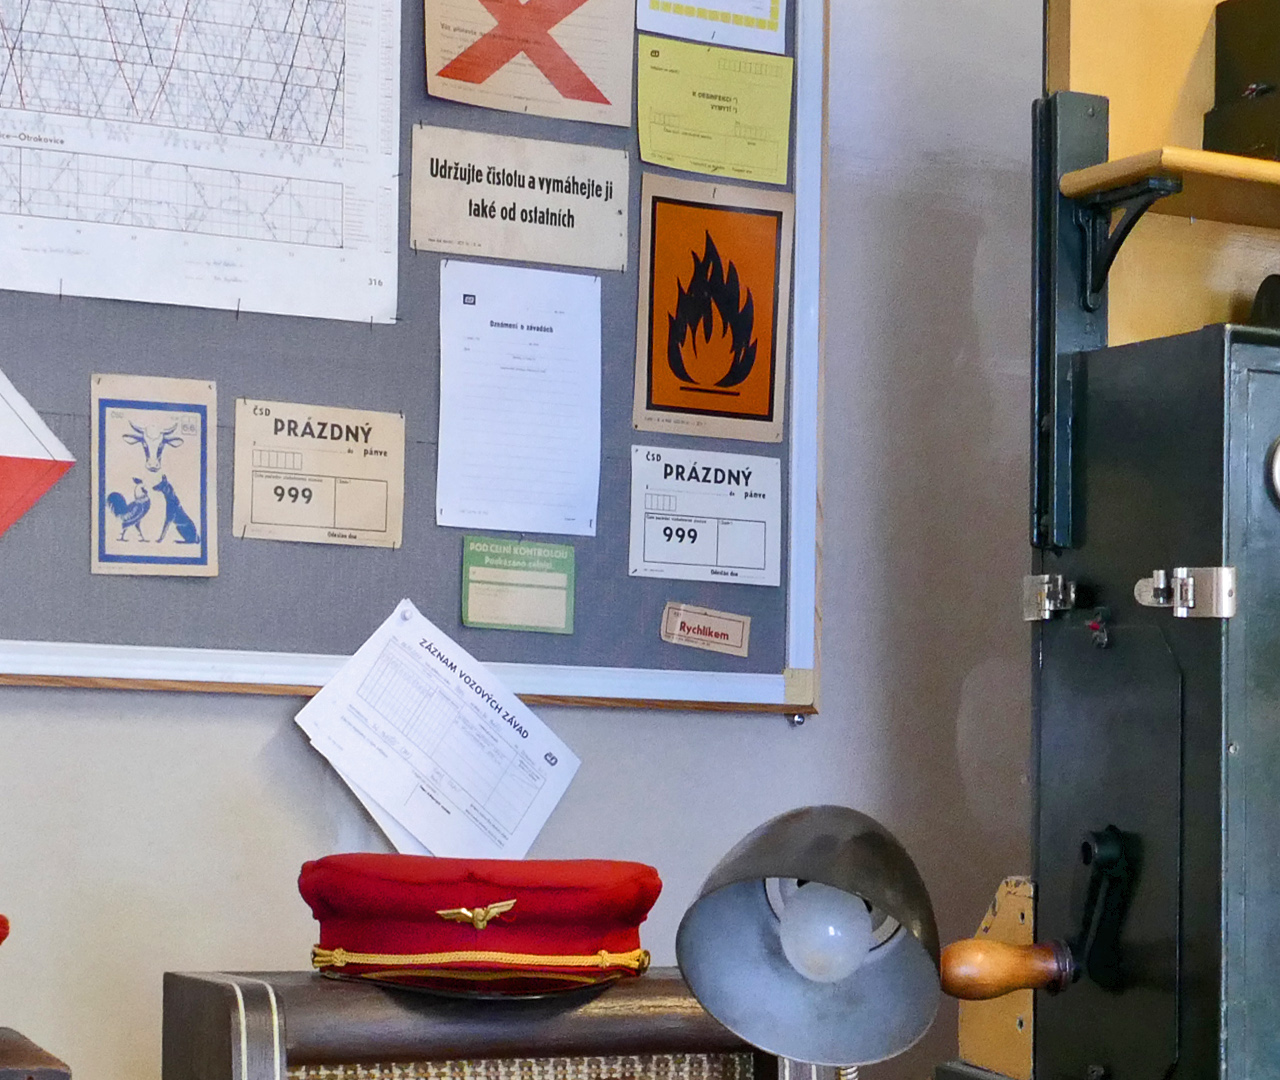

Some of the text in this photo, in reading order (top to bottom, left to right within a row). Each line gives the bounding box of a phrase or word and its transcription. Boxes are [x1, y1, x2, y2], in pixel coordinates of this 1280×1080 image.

[429, 157, 484, 186] Udržujte
[486, 165, 525, 189] čistotu
[527, 175, 536, 190] a
[538, 175, 603, 200] vymáhejte
[468, 198, 575, 229] také od ostatních
[253, 405, 271, 417] ČSD
[273, 416, 373, 444] PRÁZDNÝ
[363, 446, 388, 458] pánve
[645, 450, 662, 462] ČSD
[663, 461, 753, 487] PRÁZDNÝ
[273, 485, 314, 505] 999
[744, 490, 766, 500] pánve
[662, 526, 698, 544] 999
[418, 638, 529, 740] ZÁZNAM VOZOVÝCH ZÁVAD
